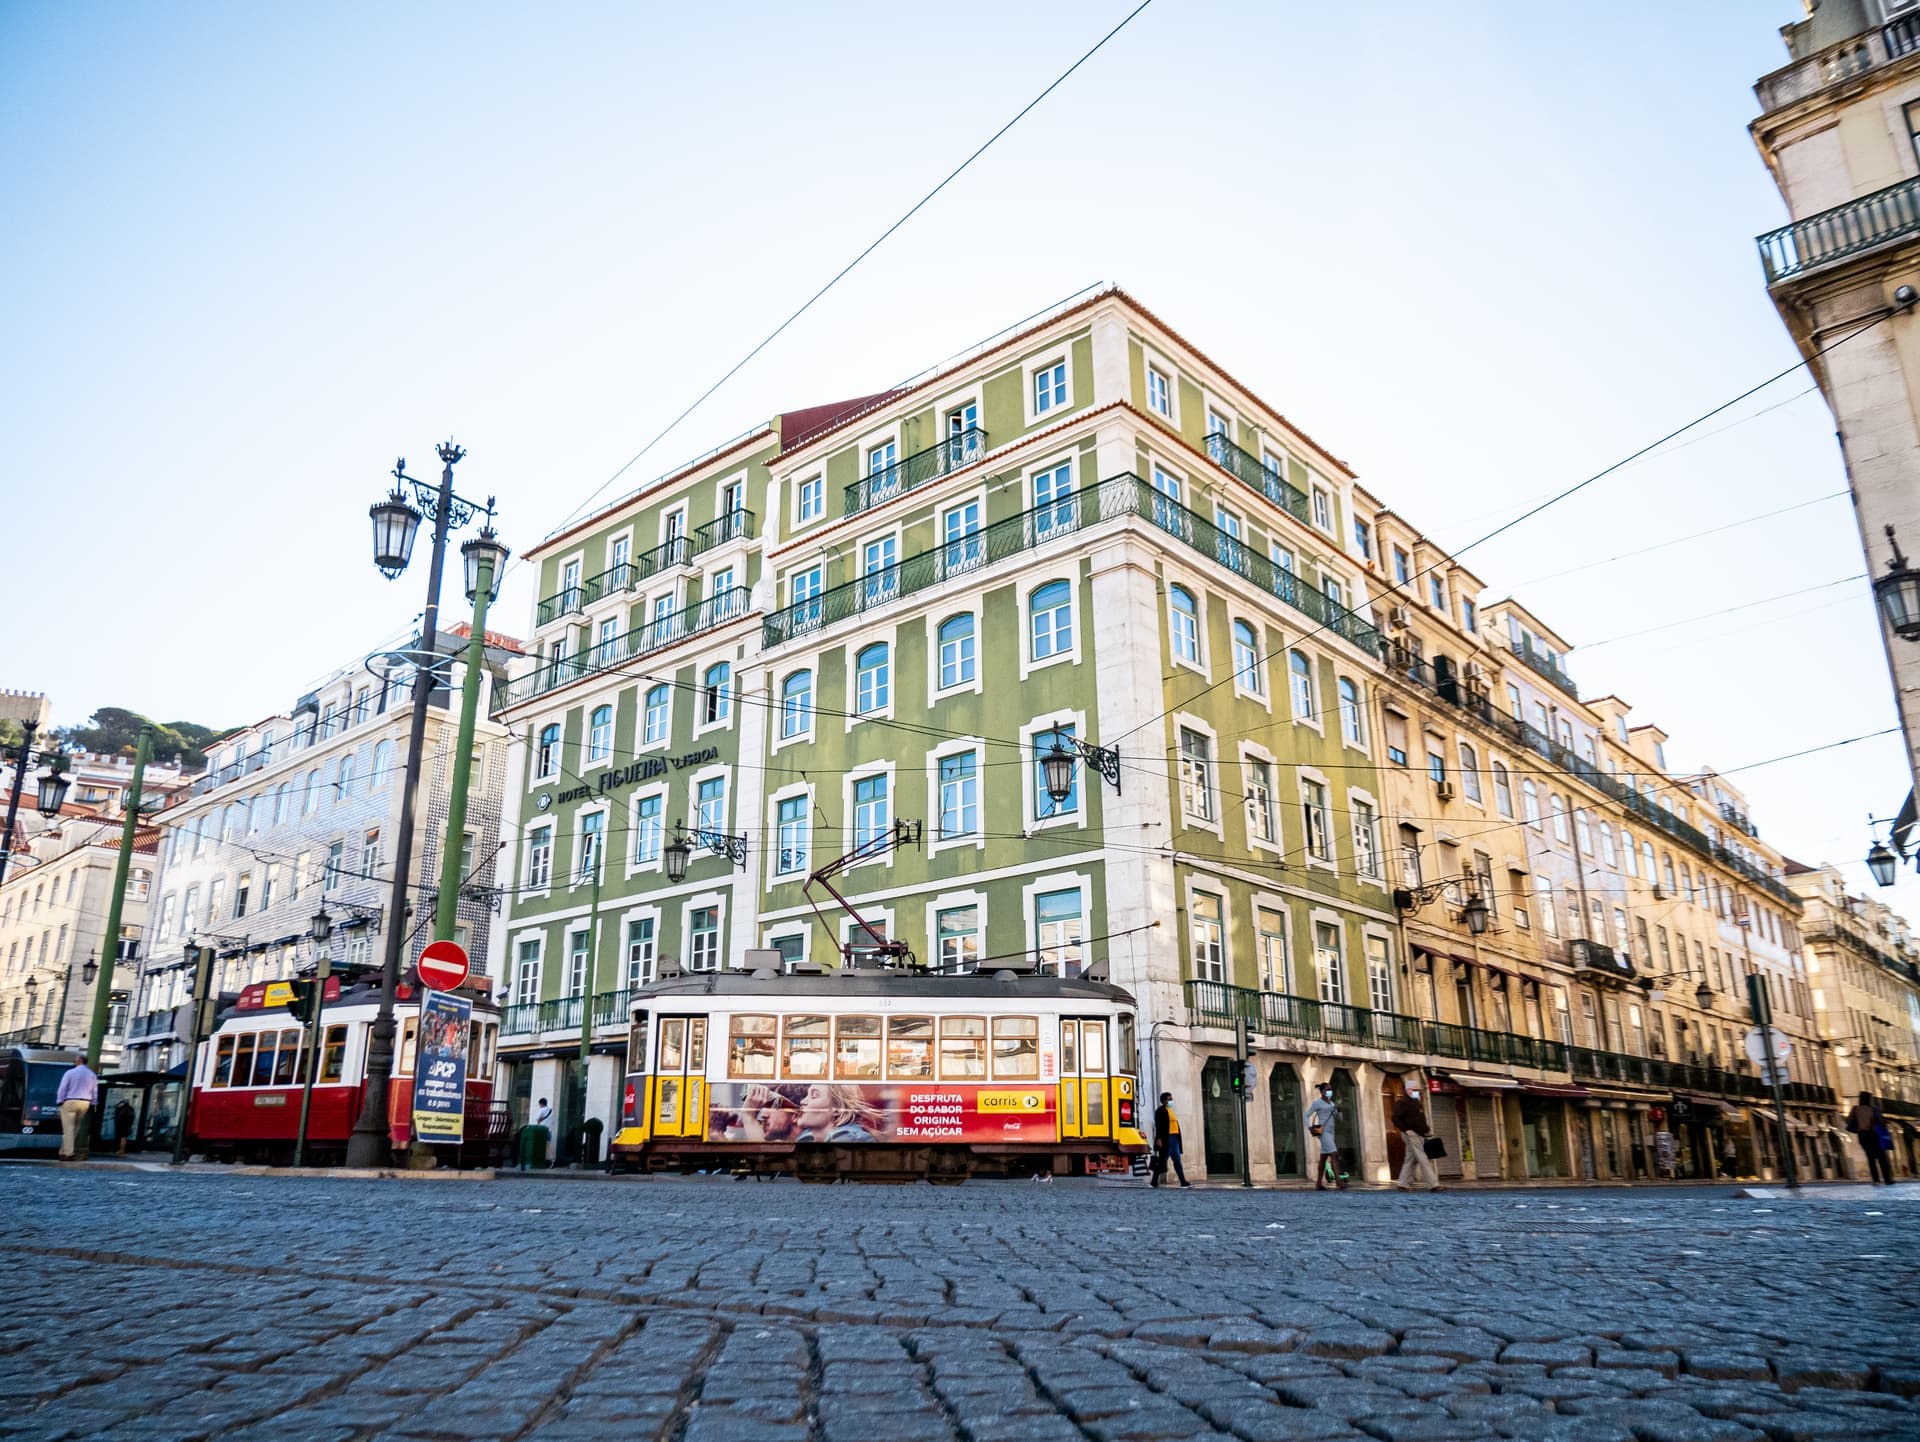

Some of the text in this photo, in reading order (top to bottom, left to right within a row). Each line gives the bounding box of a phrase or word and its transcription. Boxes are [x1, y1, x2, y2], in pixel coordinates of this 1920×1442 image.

[558, 746, 719, 804] HOTEL FIGUEIRA LISBOA
[910, 1094, 963, 1103] DESFRUTA
[983, 1095, 1017, 1107] carris
[910, 1105, 963, 1114] DO SABOR
[914, 1116, 963, 1125] ORIGINAL
[896, 1124, 963, 1138] SEM AÇÚCAR
